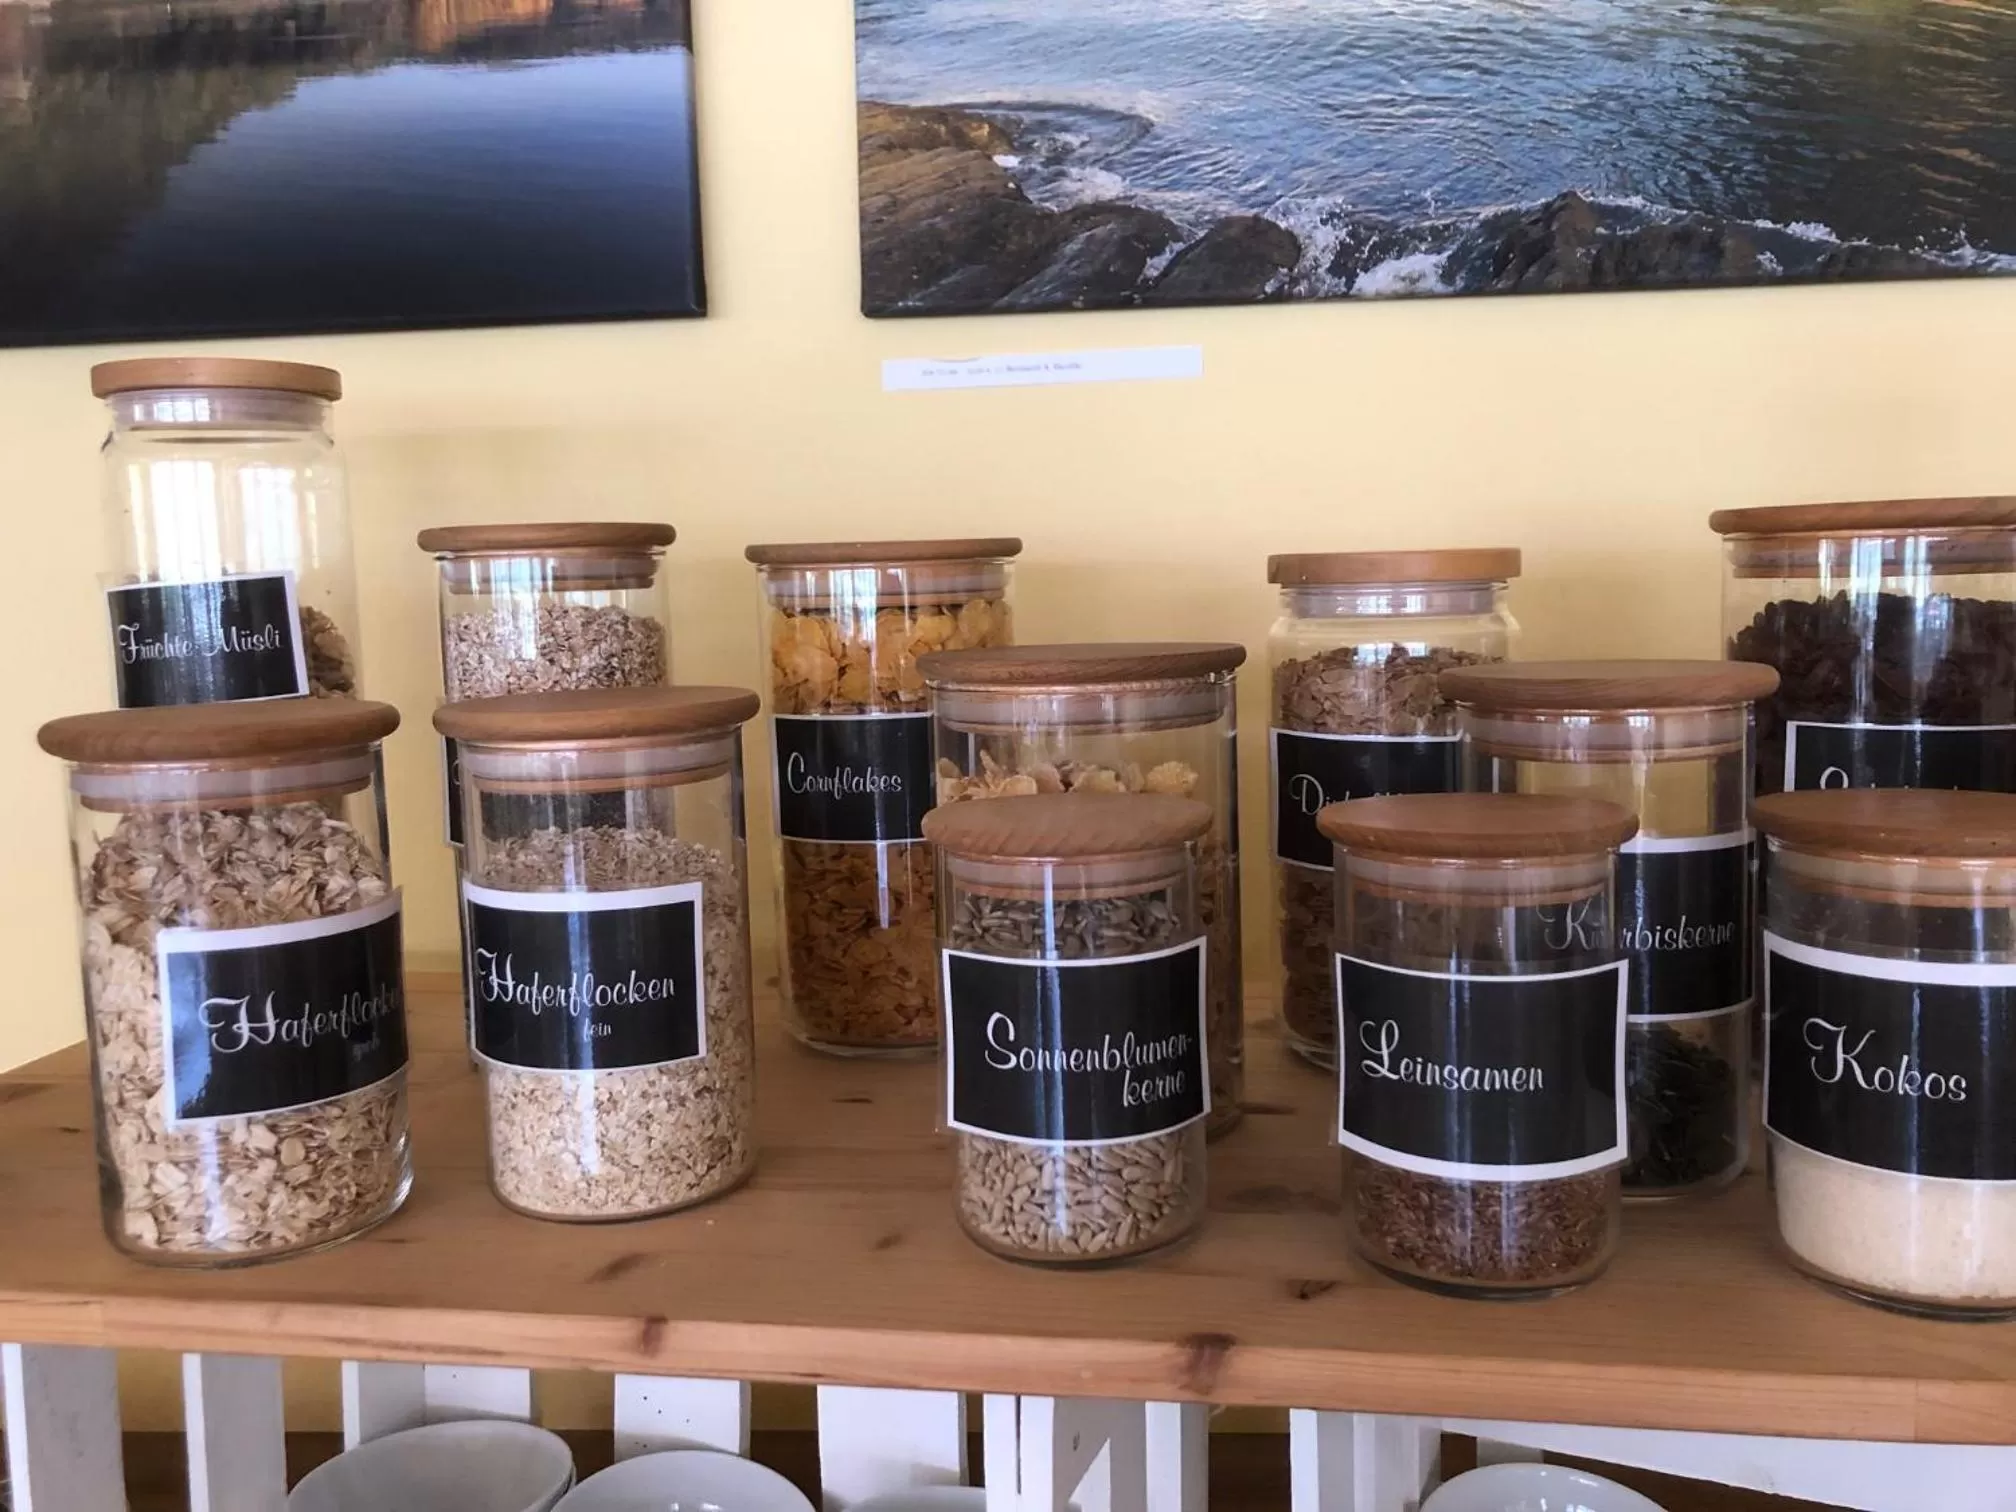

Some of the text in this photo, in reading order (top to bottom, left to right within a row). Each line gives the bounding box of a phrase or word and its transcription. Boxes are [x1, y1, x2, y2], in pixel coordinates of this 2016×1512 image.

[787, 751, 903, 800] Cornflakes
[475, 946, 676, 1016] Haferflocken
[198, 981, 399, 1053] Haferflock
[582, 1016, 612, 1042] fein
[984, 1011, 1193, 1073] Sonnenblumen-
[1122, 1069, 1187, 1108] kerne
[1358, 1019, 1545, 1092] Leinsamen
[1802, 1016, 1968, 1101] Kokos
